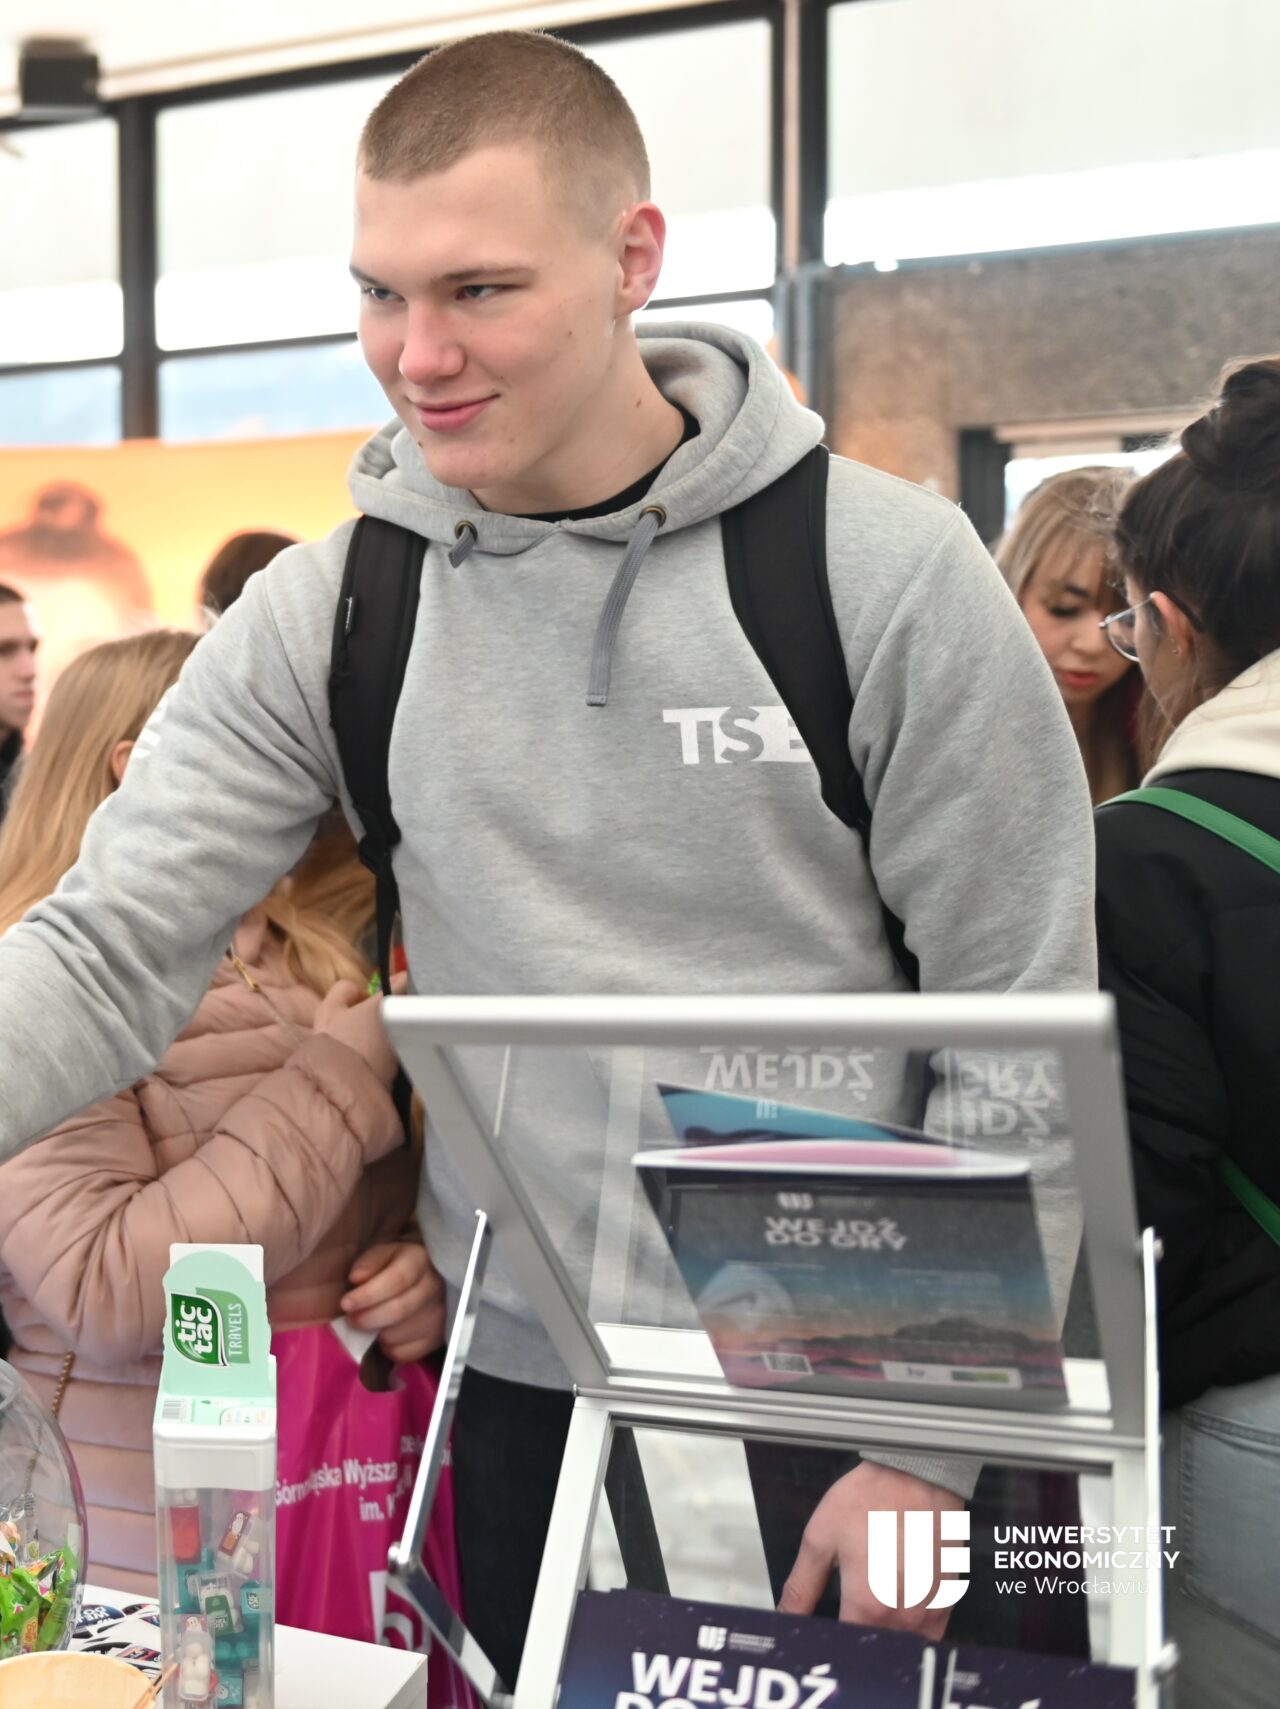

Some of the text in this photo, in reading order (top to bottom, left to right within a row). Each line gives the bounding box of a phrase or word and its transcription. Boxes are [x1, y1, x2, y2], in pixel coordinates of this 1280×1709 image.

[175, 1304, 197, 1343] tic
[194, 1306, 214, 1354] tac
[228, 1302, 243, 1356] TRAVELS
[343, 1457, 398, 1490] Wyższa
[631, 1650, 838, 1709] WEJDŹ
